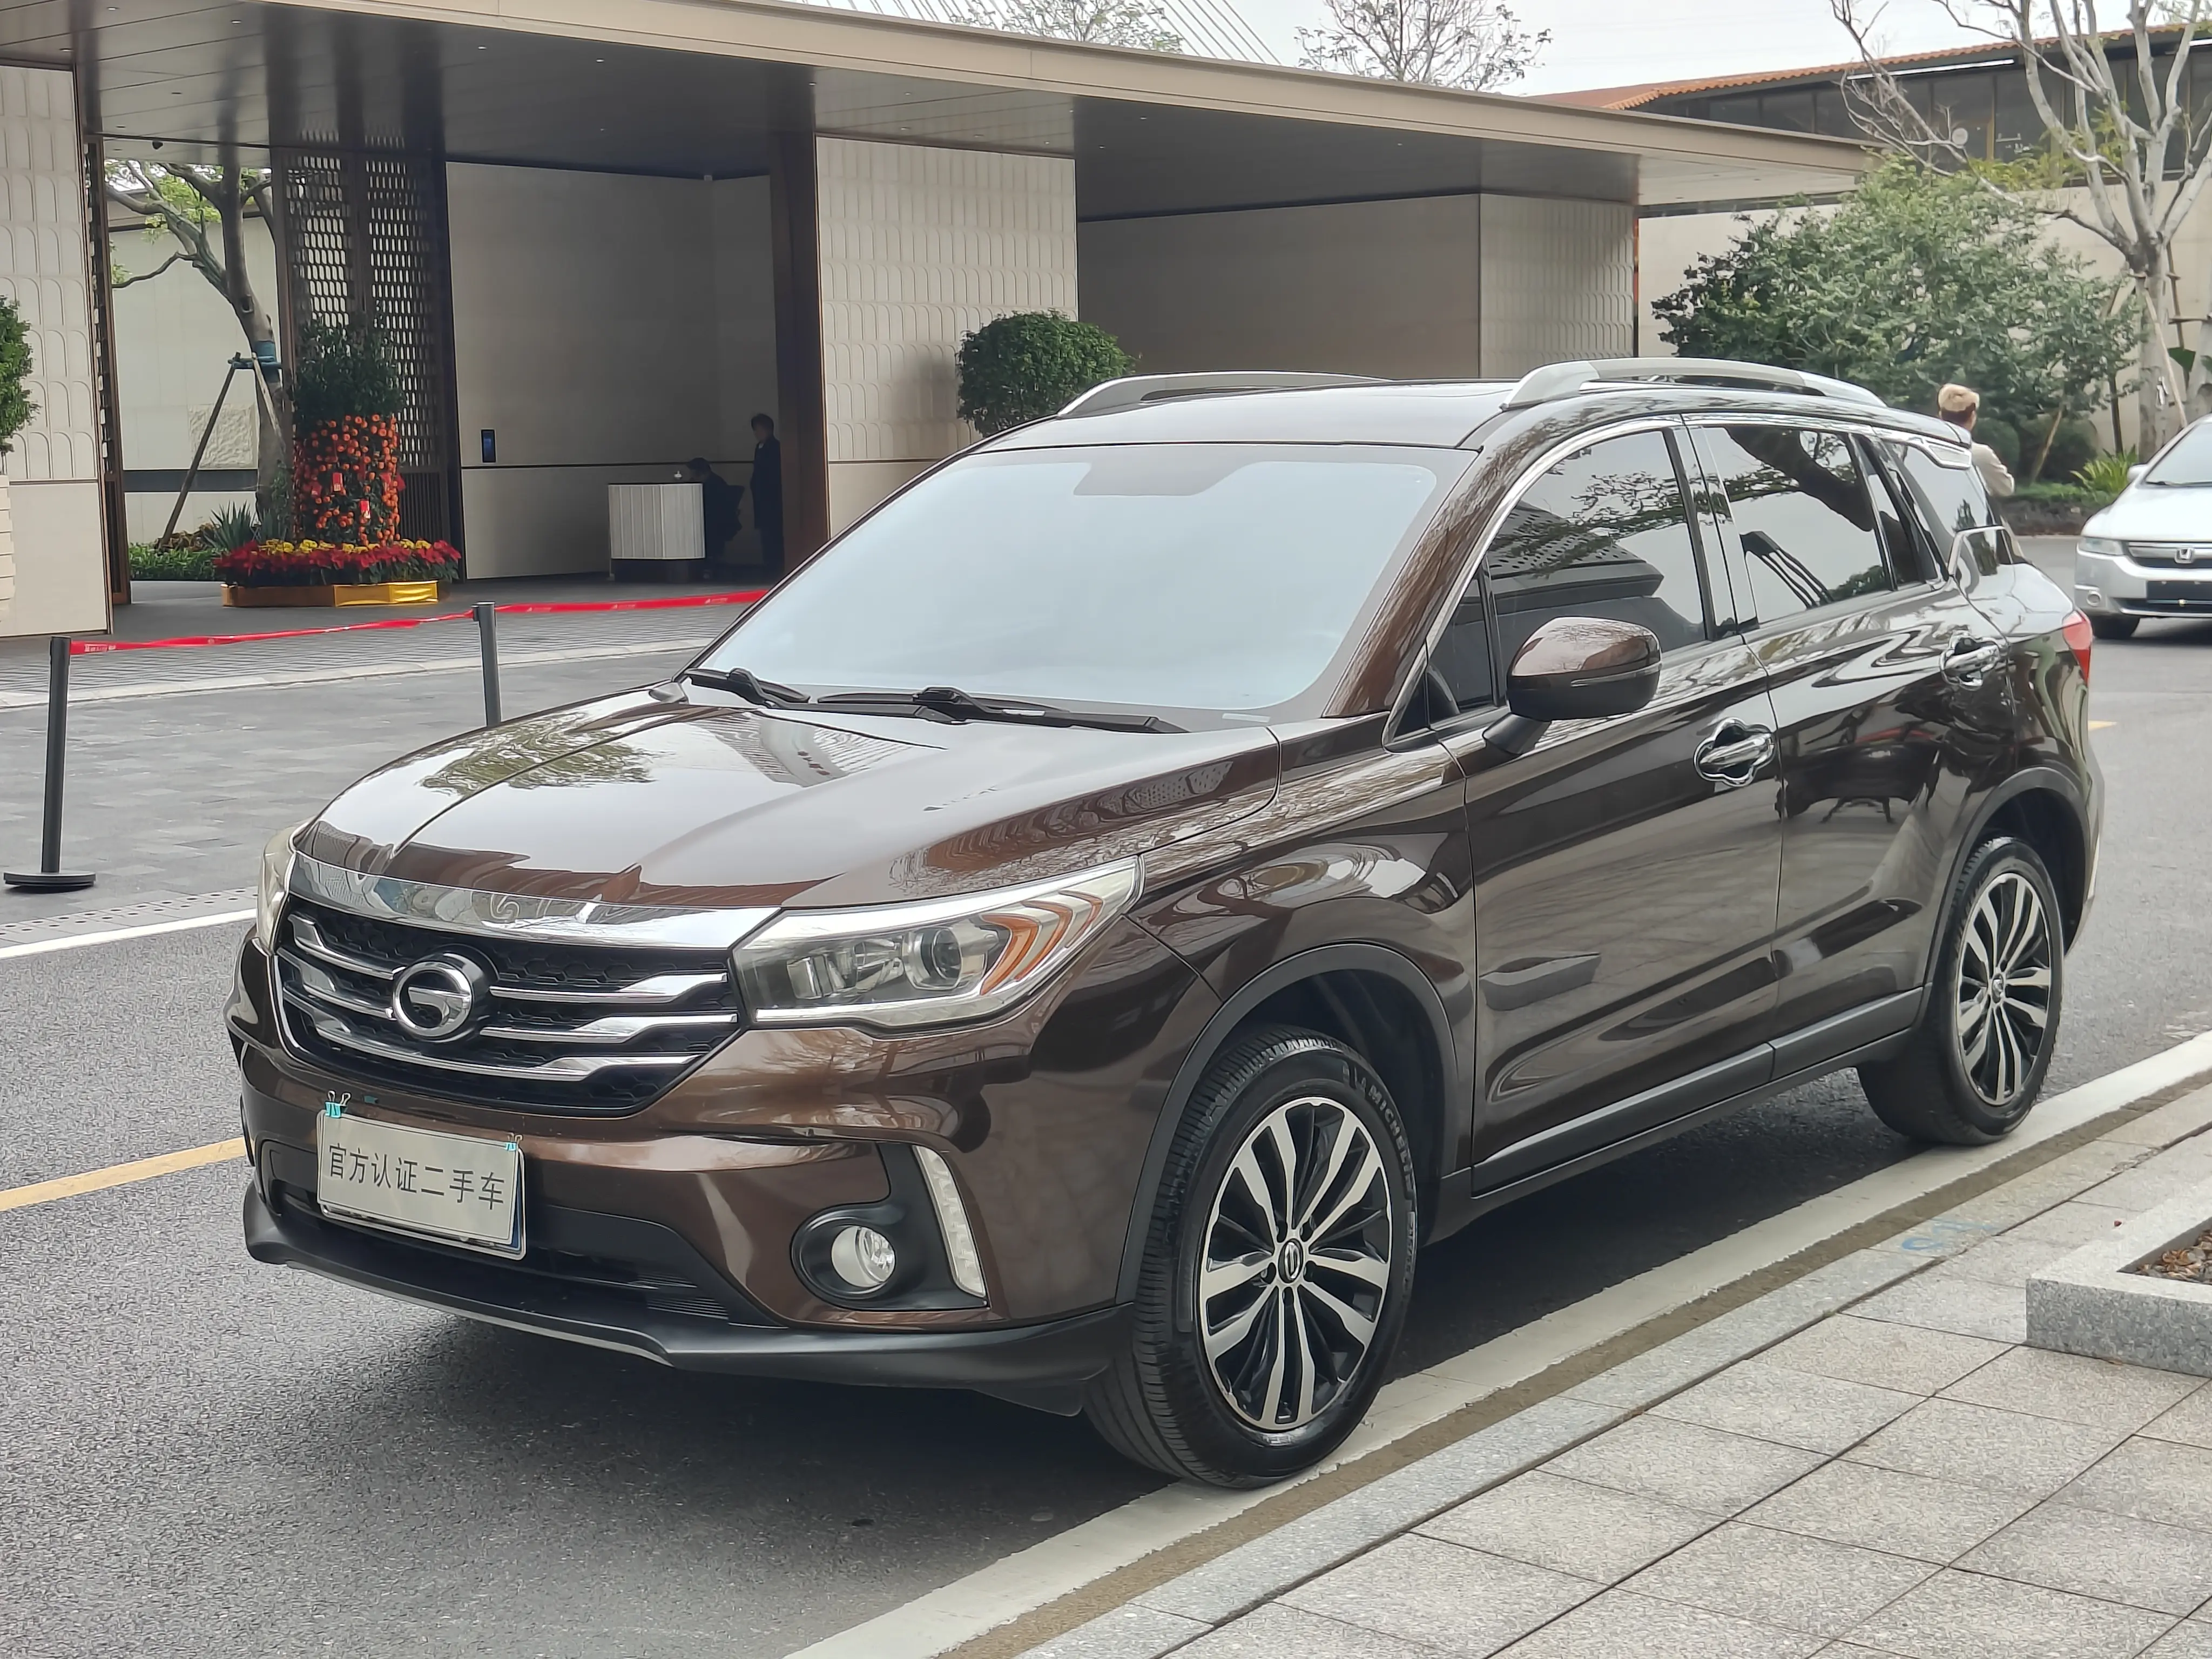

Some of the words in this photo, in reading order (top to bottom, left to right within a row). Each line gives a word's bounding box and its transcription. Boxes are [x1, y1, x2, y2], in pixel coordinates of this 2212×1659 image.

[329, 1143, 505, 1210] 官方认证二手车
